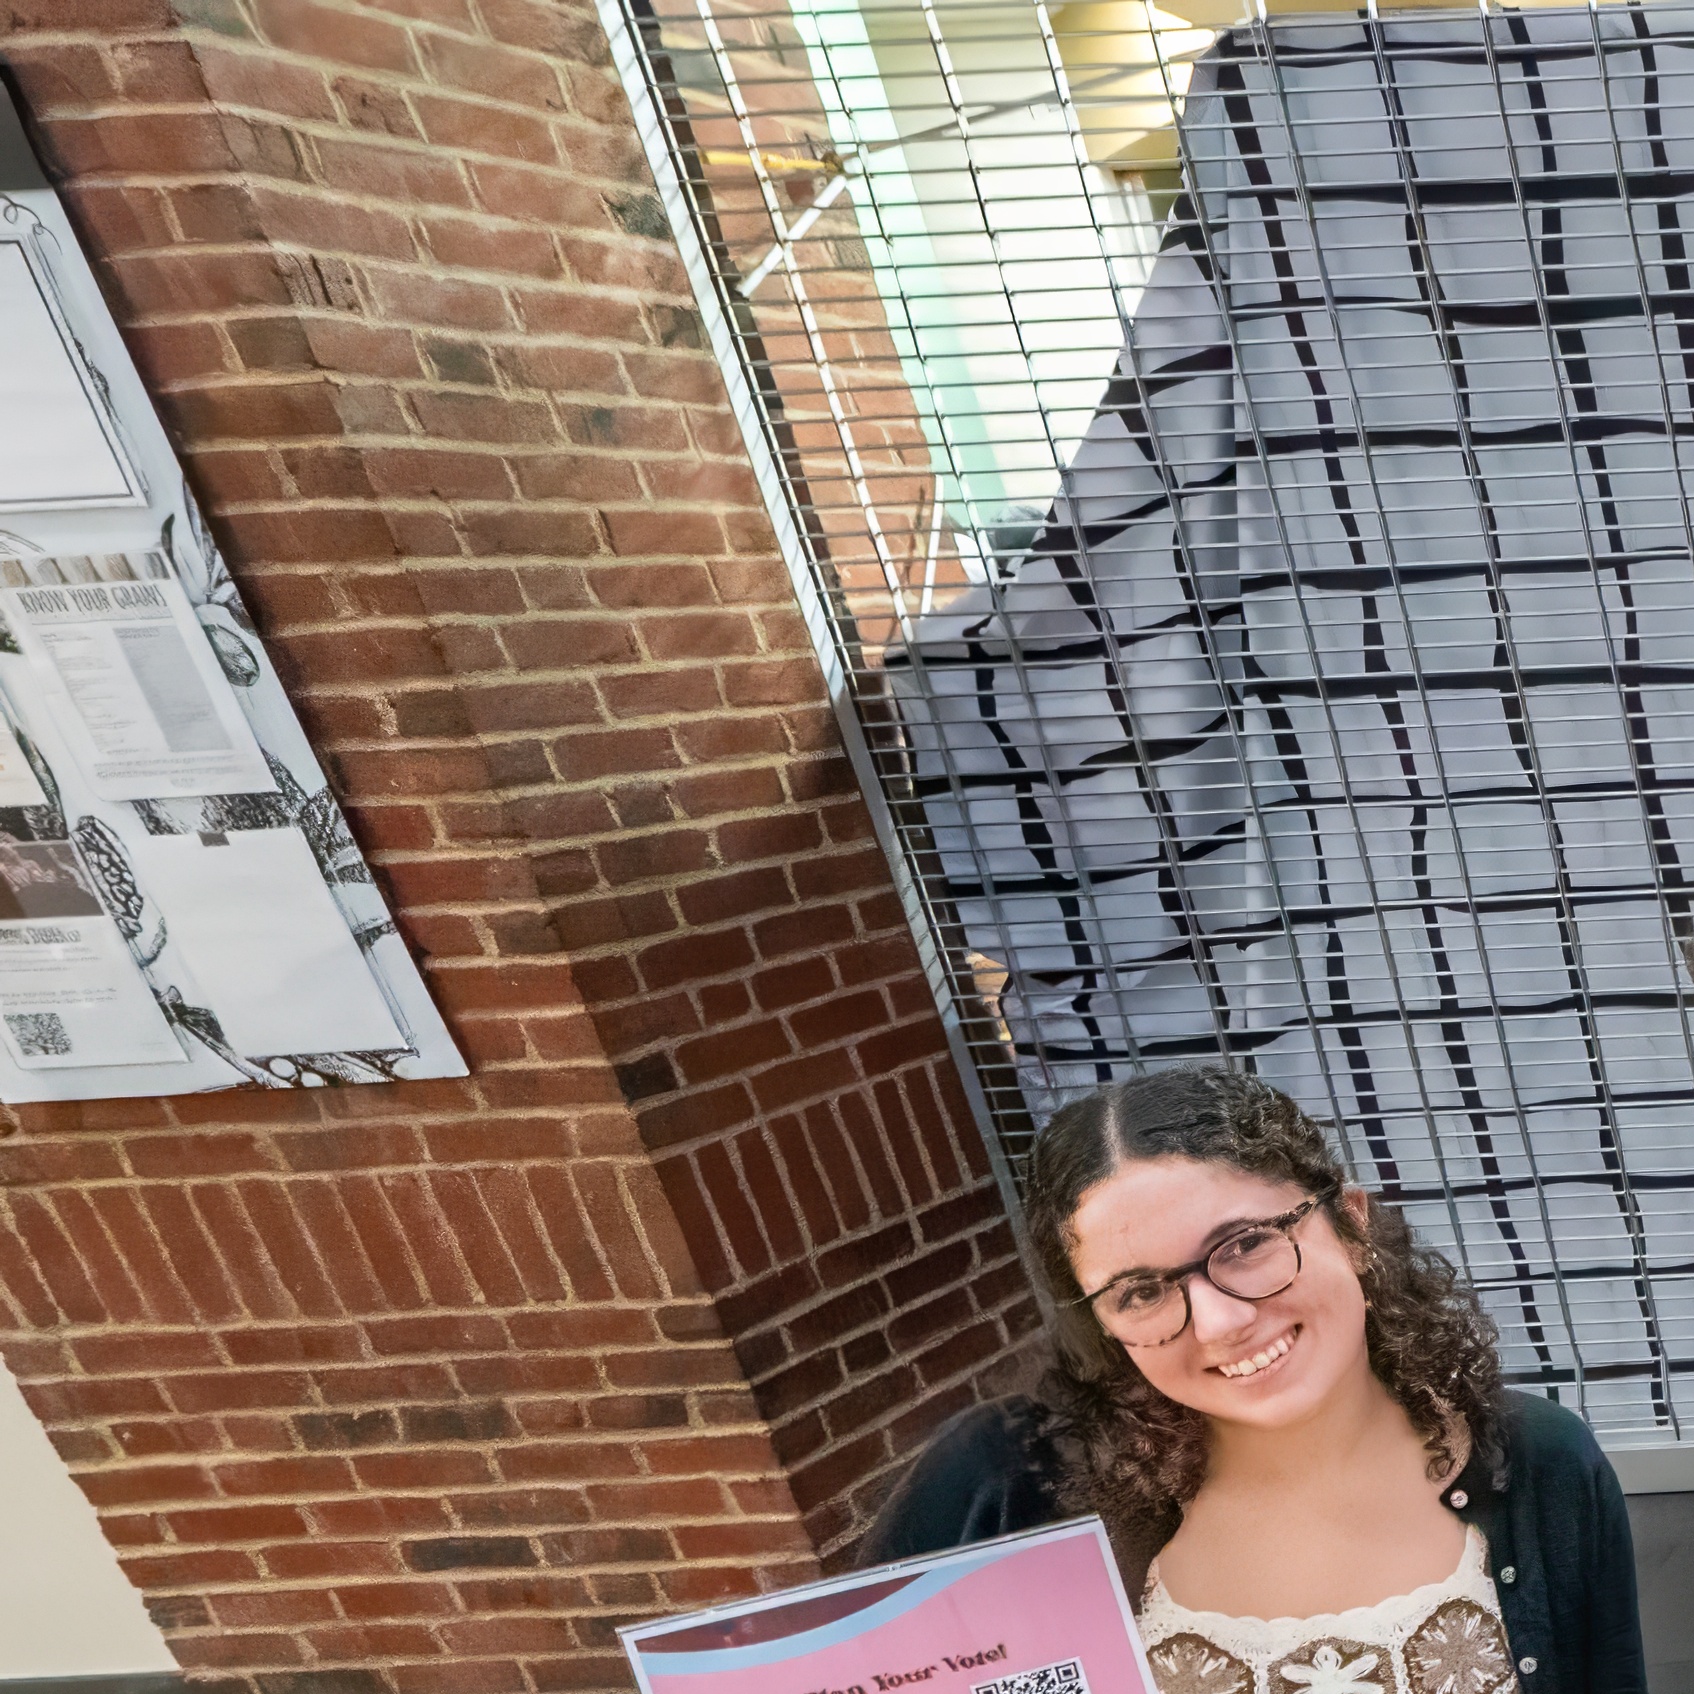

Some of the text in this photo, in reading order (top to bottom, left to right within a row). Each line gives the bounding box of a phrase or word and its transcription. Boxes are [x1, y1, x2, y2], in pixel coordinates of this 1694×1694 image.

[17, 588, 69, 614] KNOW
[68, 587, 112, 612] YOUR
[871, 1665, 937, 1692] Your
[942, 1643, 1009, 1672] Vote!
